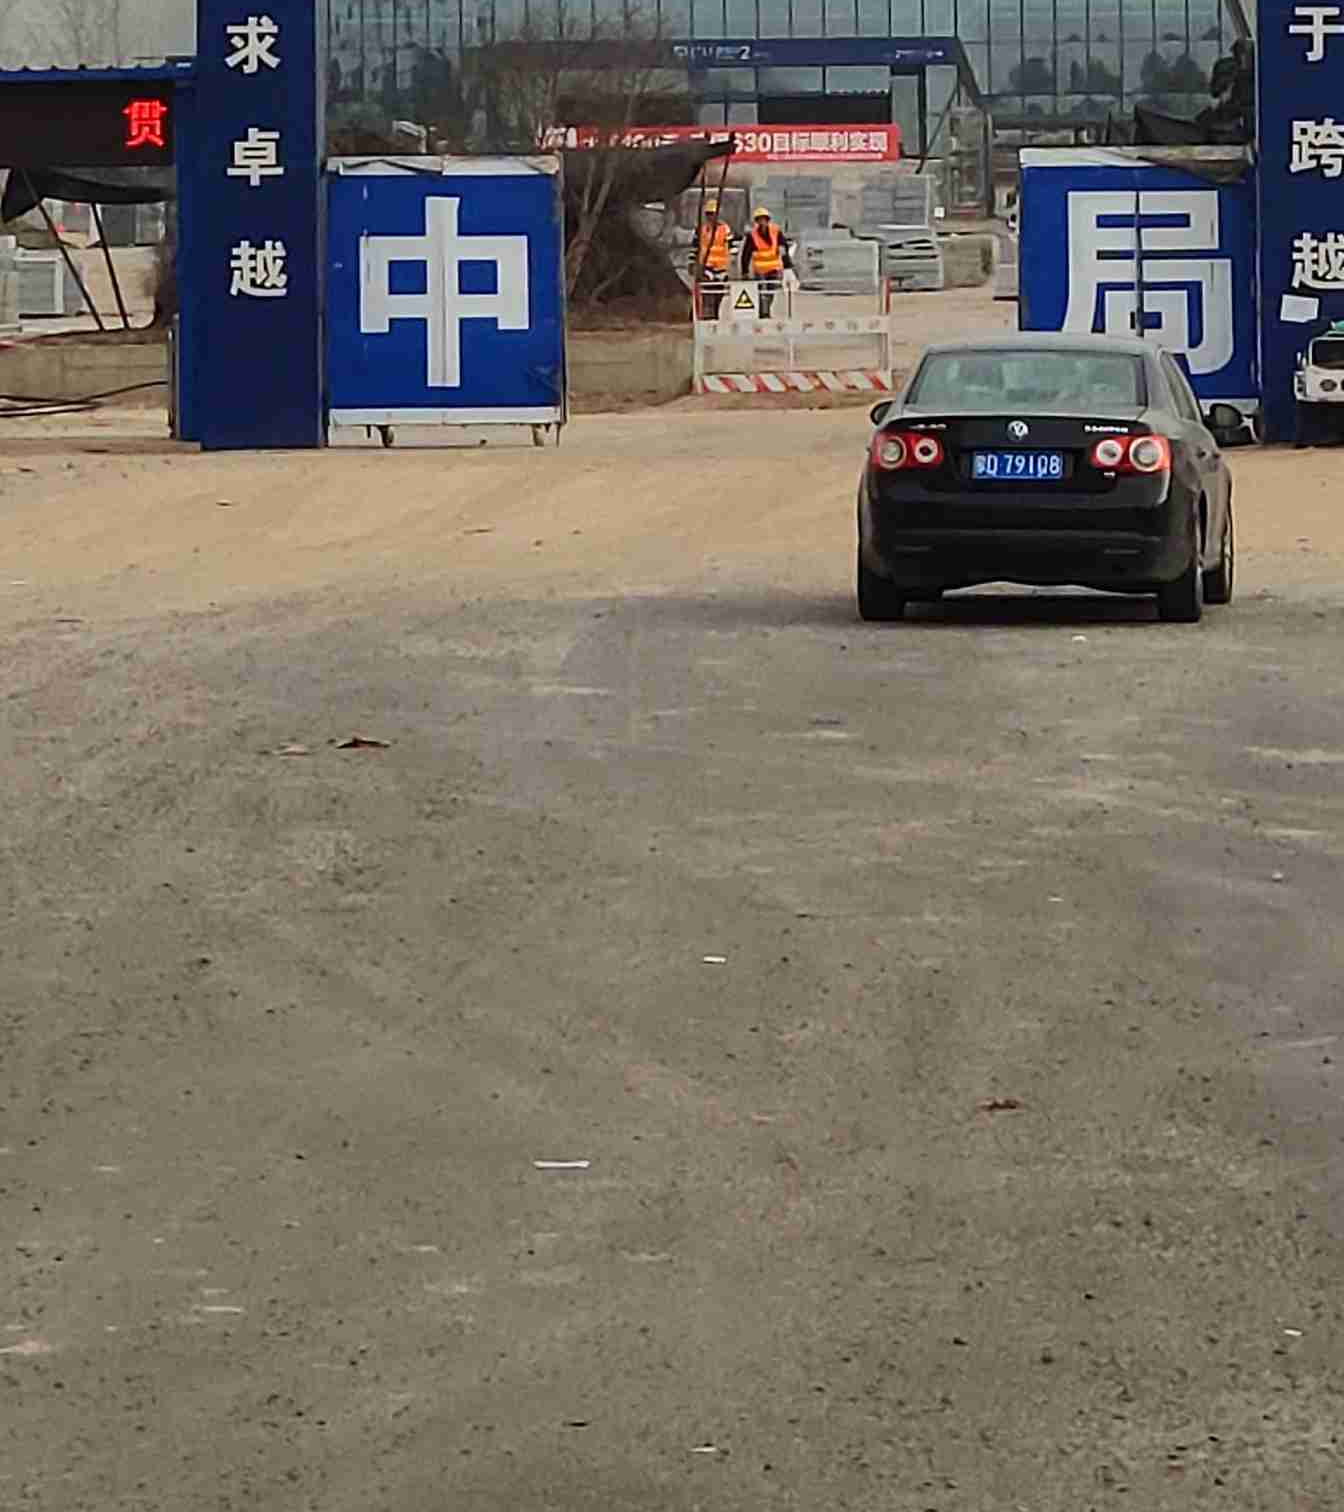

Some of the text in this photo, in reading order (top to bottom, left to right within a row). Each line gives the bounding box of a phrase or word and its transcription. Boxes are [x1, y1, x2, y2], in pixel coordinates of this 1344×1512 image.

[125, 99, 168, 148] 贯
[359, 196, 530, 388] 中
[1061, 189, 1235, 376] 局
